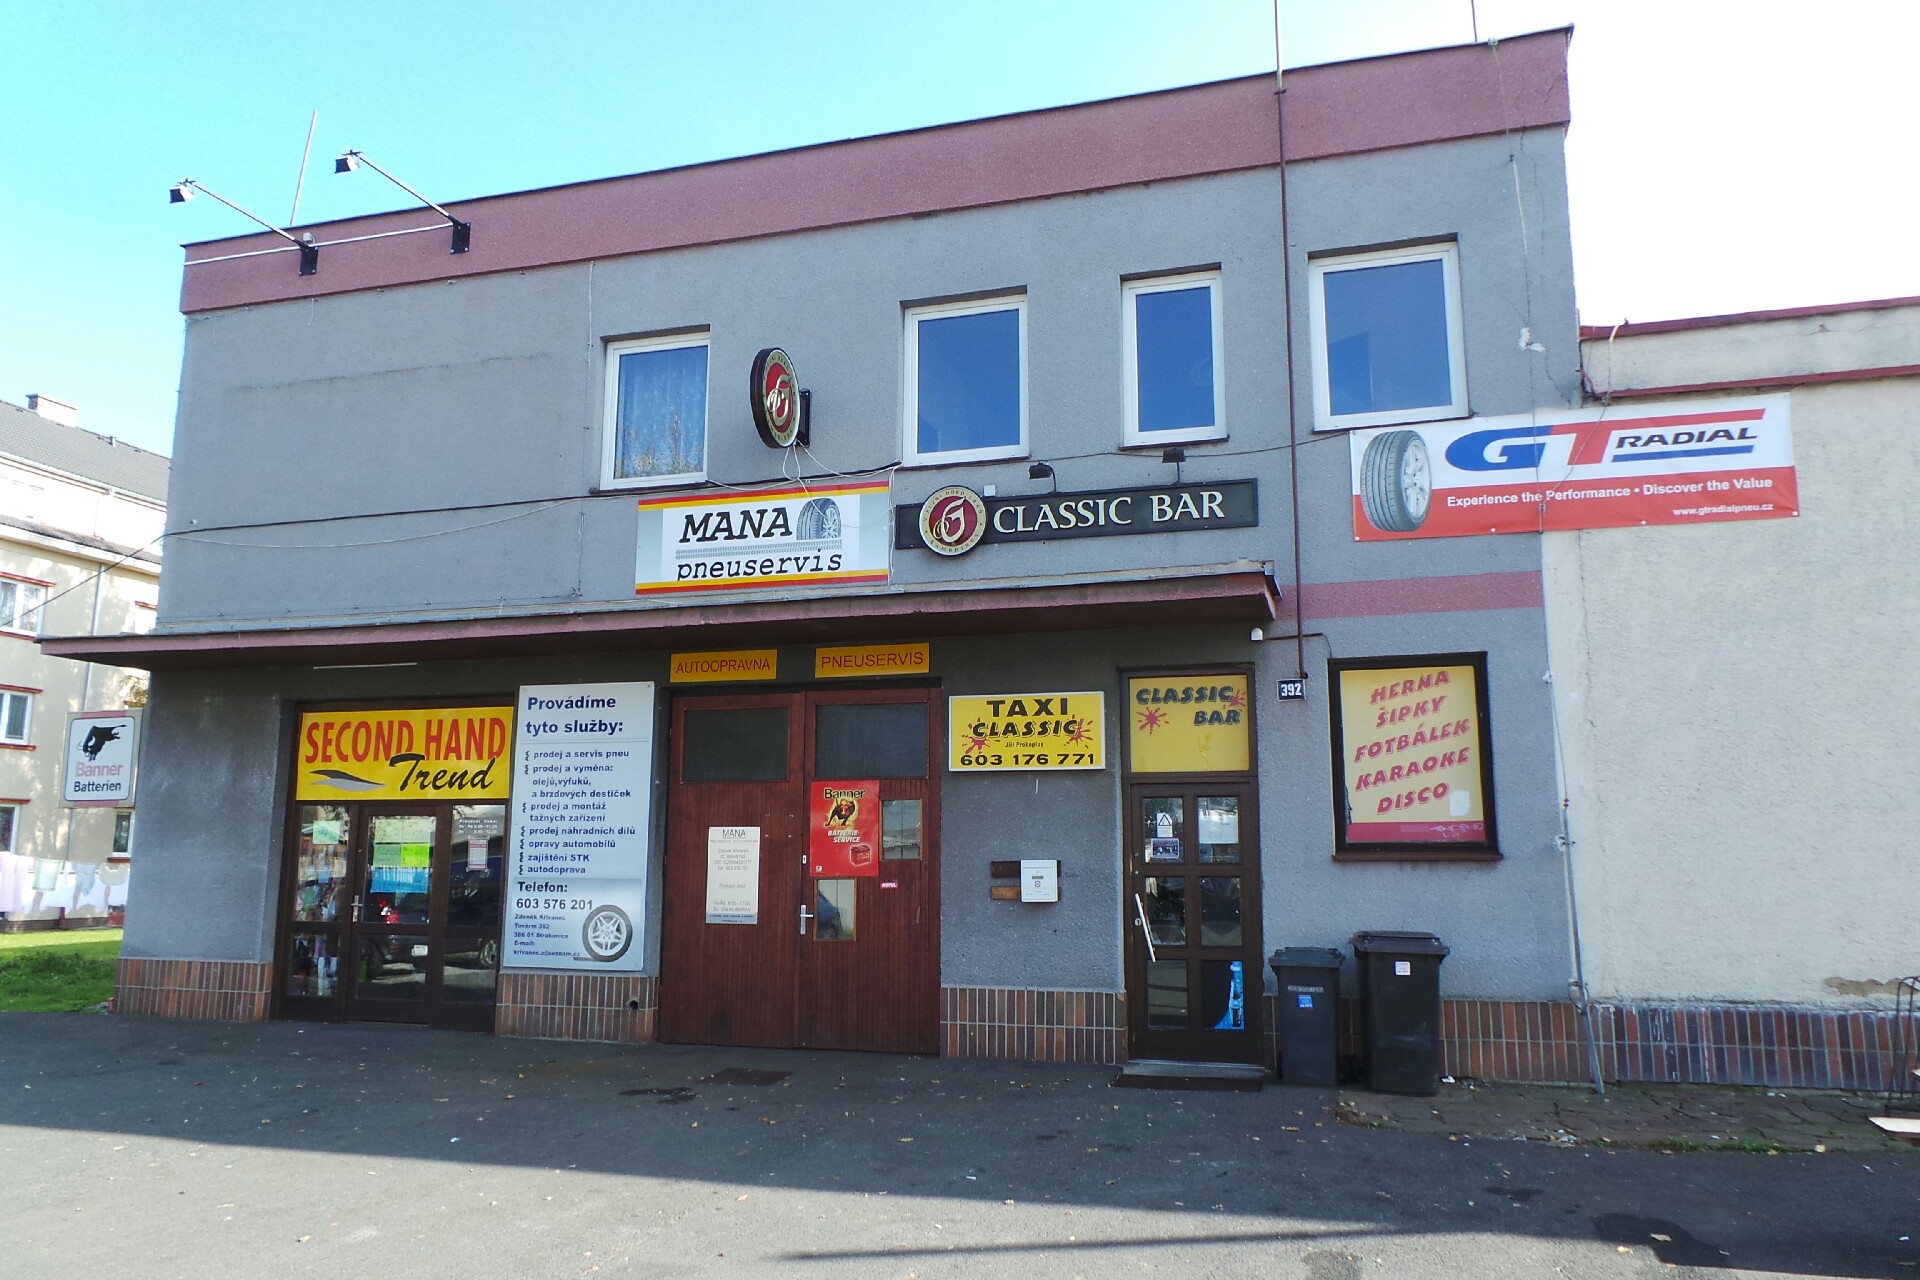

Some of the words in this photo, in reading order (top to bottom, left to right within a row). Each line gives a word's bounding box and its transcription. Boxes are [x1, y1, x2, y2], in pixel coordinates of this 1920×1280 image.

[1615, 427, 1758, 449] RADIAL
[1447, 494, 1518, 508] Experience
[1521, 492, 1543, 502] the
[1546, 487, 1630, 501] Performance
[1643, 482, 1703, 496] Discover
[1706, 480, 1730, 491] the
[1732, 477, 1773, 489] Value
[993, 496, 1132, 534] CLASSIC
[1149, 490, 1225, 523] BAR
[1672, 503, 1774, 516] www.gtradialpneu.cz
[679, 507, 793, 544] MANA
[676, 548, 843, 582] pneuservis
[675, 657, 771, 674] AUTOOPRAVNA
[821, 651, 924, 669] PNEUSERVIS
[1136, 685, 1234, 705] CLASSIC
[1280, 683, 1302, 697] 392
[1370, 670, 1450, 705] HERNA
[527, 694, 617, 711] Provádíme
[986, 697, 1068, 718] TAXI
[1193, 709, 1241, 726] BAR
[1375, 695, 1448, 729] ŠIPKY
[526, 721, 559, 737] tyto
[564, 719, 623, 736] služby:
[972, 719, 1079, 738] CLASSIC
[305, 719, 415, 764] SECOND
[424, 717, 506, 761] HAND
[1354, 718, 1470, 763] FOTBÁLEK
[533, 750, 563, 760] prodej
[574, 750, 603, 758] servis
[606, 751, 630, 760] pneu
[960, 754, 1003, 766] 603
[1012, 753, 1049, 766] 176
[1056, 753, 1094, 765] 771
[75, 761, 124, 777] Banner
[389, 753, 496, 792] Trend
[533, 765, 562, 774] prodej
[573, 764, 613, 775] výměna:
[1355, 747, 1470, 791] KARAOKE
[73, 780, 122, 792] Batterien
[824, 788, 865, 799] Banner
[540, 790, 587, 801] brzdových
[590, 789, 631, 798] destiček
[1377, 782, 1449, 815] DISCO
[530, 802, 560, 812] prodej
[571, 801, 606, 810] montáž
[529, 814, 566, 825] tažných
[568, 813, 605, 822] zařízení
[529, 826, 559, 836] prodej
[561, 826, 615, 835] náhradních
[617, 826, 635, 835] dílů
[722, 829, 747, 838] MANA
[528, 841, 560, 850] opravy
[562, 840, 616, 849] automobilů
[527, 853, 568, 863] zajištění
[527, 866, 586, 875] autodoprava
[517, 881, 568, 893] Telefon:
[516, 898, 539, 909] 603
[543, 899, 566, 910] 576
[570, 899, 593, 910] 201
